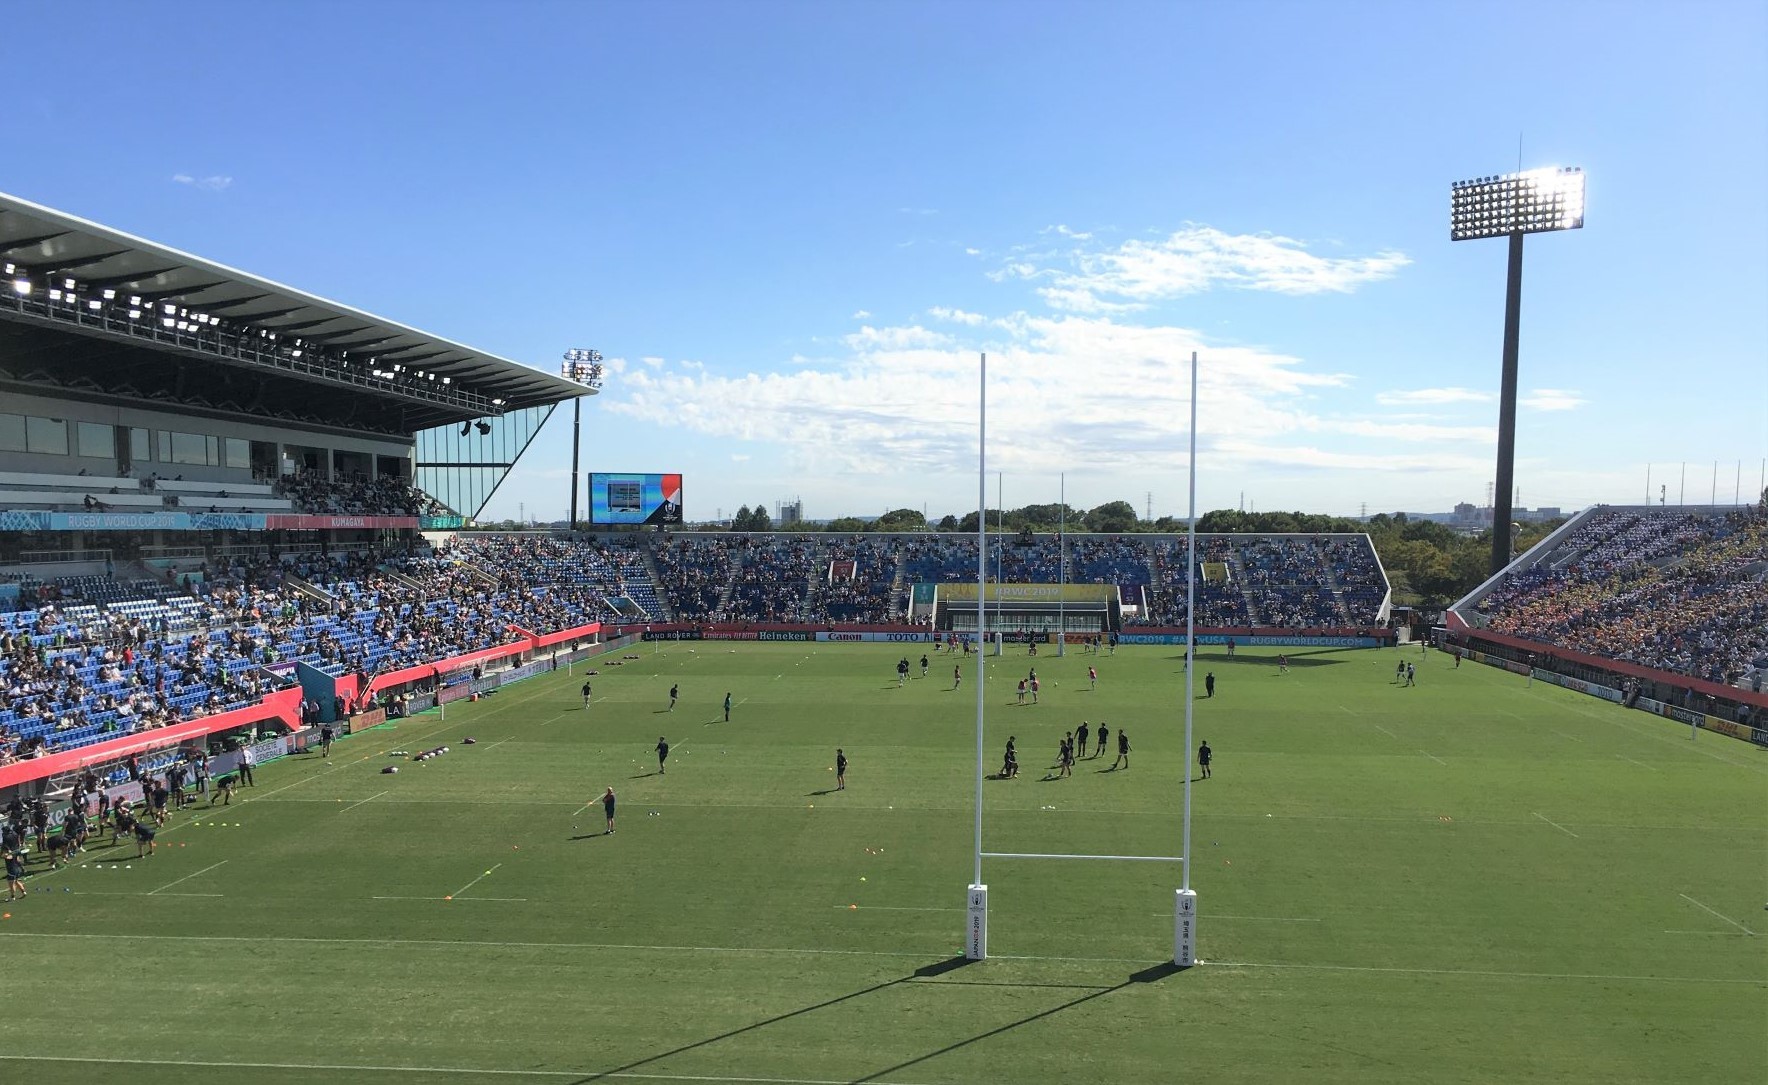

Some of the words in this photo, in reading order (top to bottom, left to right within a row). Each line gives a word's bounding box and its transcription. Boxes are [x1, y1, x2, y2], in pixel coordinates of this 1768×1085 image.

[69, 515, 102, 528] RUGBY
[104, 515, 138, 528] WORLD
[140, 516, 156, 528] CUP
[158, 516, 175, 527] 2019
[331, 517, 365, 528] KUMAGAYA
[995, 587, 1060, 597] #RWC2019
[667, 632, 691, 640] ROVER
[703, 632, 731, 640] Emirates
[759, 631, 807, 641] Heineken
[828, 633, 862, 641] Canon
[886, 633, 919, 641] TOTO
[1251, 637, 1364, 646] RUGBYWORLDCUP.COM
